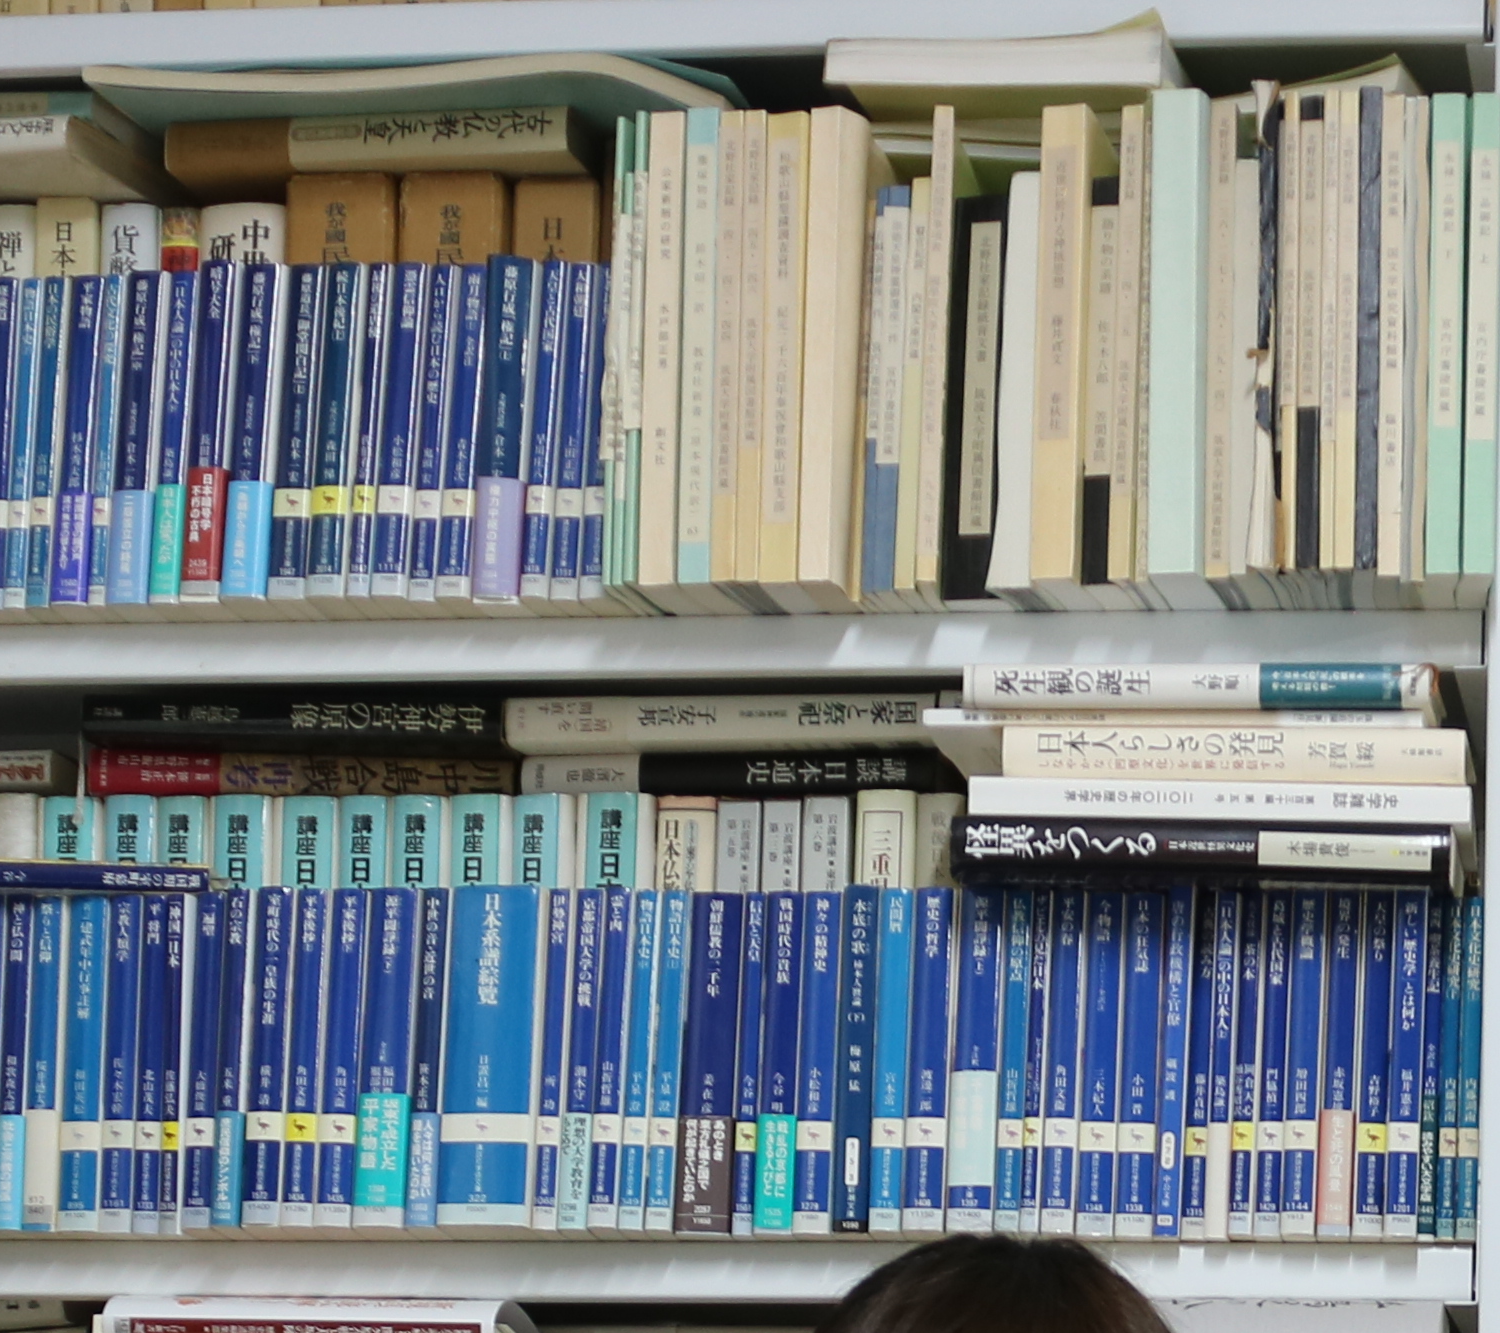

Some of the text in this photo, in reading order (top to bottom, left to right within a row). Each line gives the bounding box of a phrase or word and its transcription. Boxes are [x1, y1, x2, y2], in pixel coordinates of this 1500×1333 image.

[992, 669, 1152, 696] 死生観の誕生
[1035, 731, 1286, 758] 日本人らしさの発見
